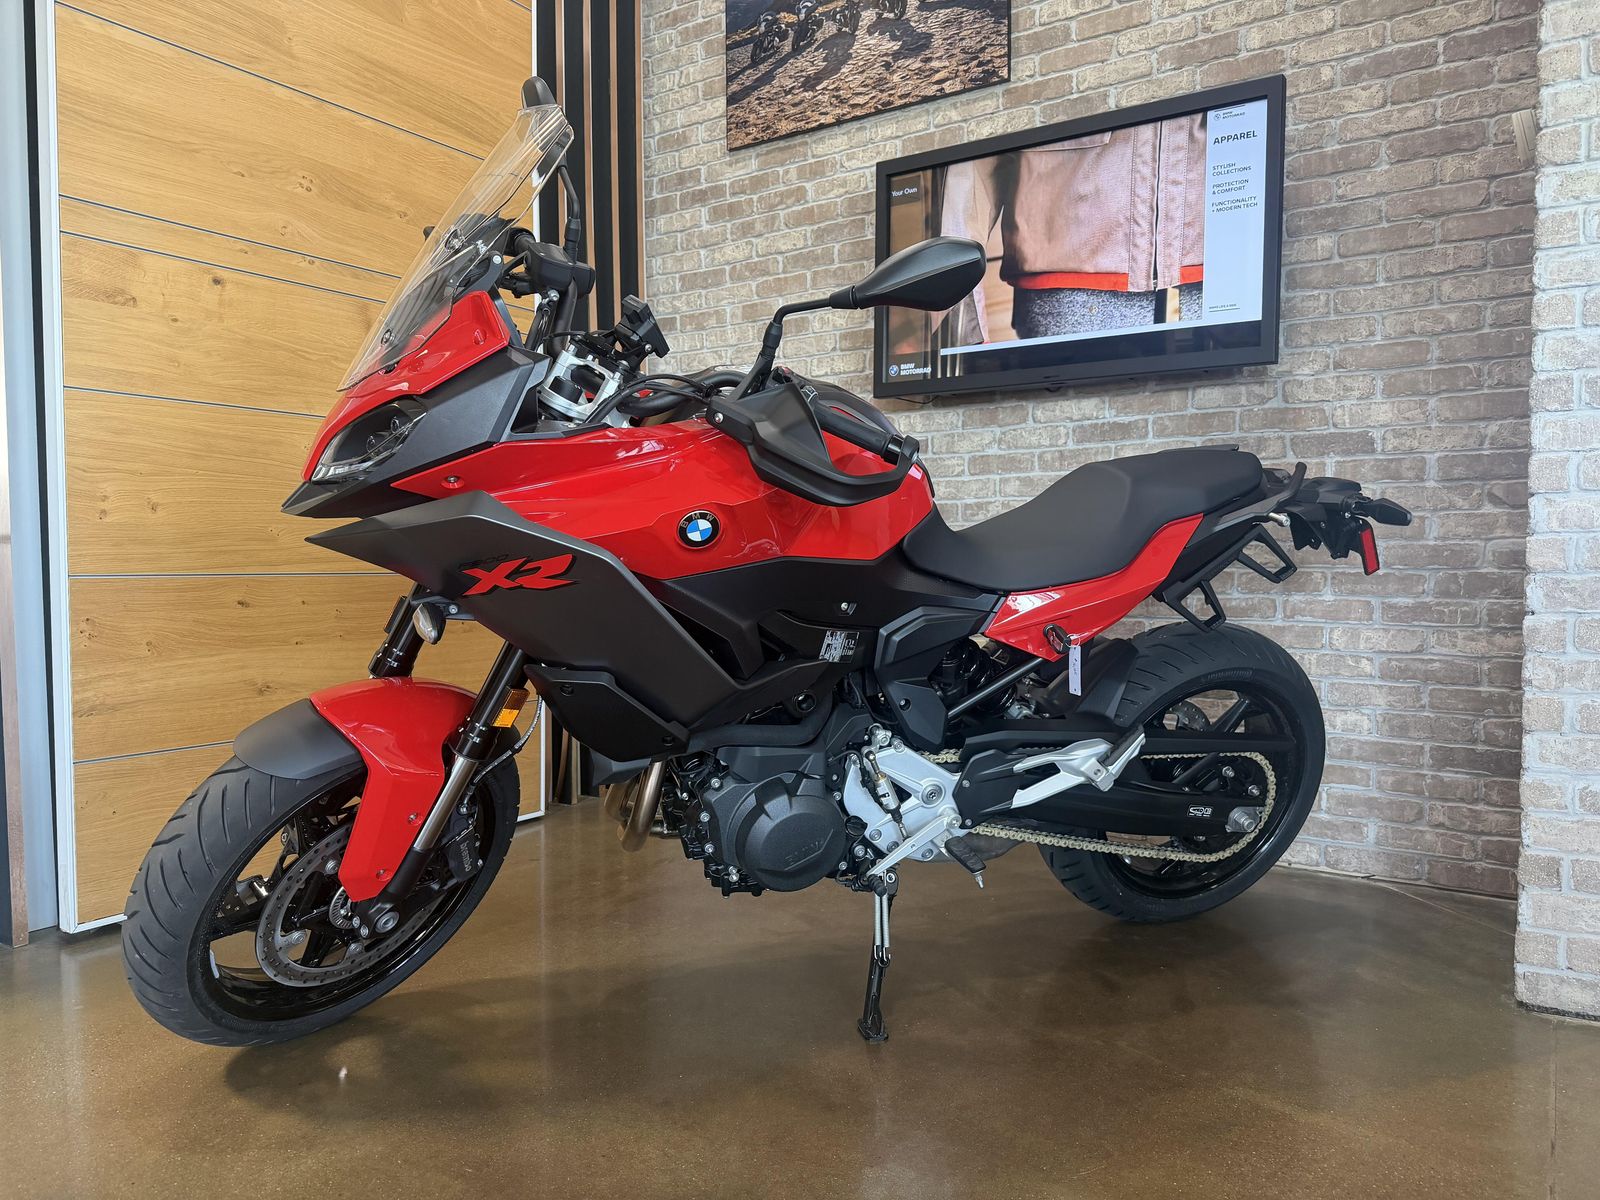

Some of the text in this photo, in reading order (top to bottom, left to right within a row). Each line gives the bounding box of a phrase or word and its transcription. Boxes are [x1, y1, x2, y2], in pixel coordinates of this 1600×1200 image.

[1213, 130, 1258, 145] APPAREL
[1212, 163, 1236, 171] STYLISH
[1212, 166, 1252, 177] COLLECTIONS
[1212, 179, 1249, 189] PROTECTION
[904, 187, 918, 195] Own
[1217, 185, 1246, 195] COMFORT
[1211, 196, 1257, 207] FUNCTIONALITY
[1216, 205, 1242, 213] MODERN
[900, 367, 932, 376] MOTORRAD
[680, 512, 715, 529] BMW
[460, 840, 473, 872] brembo
